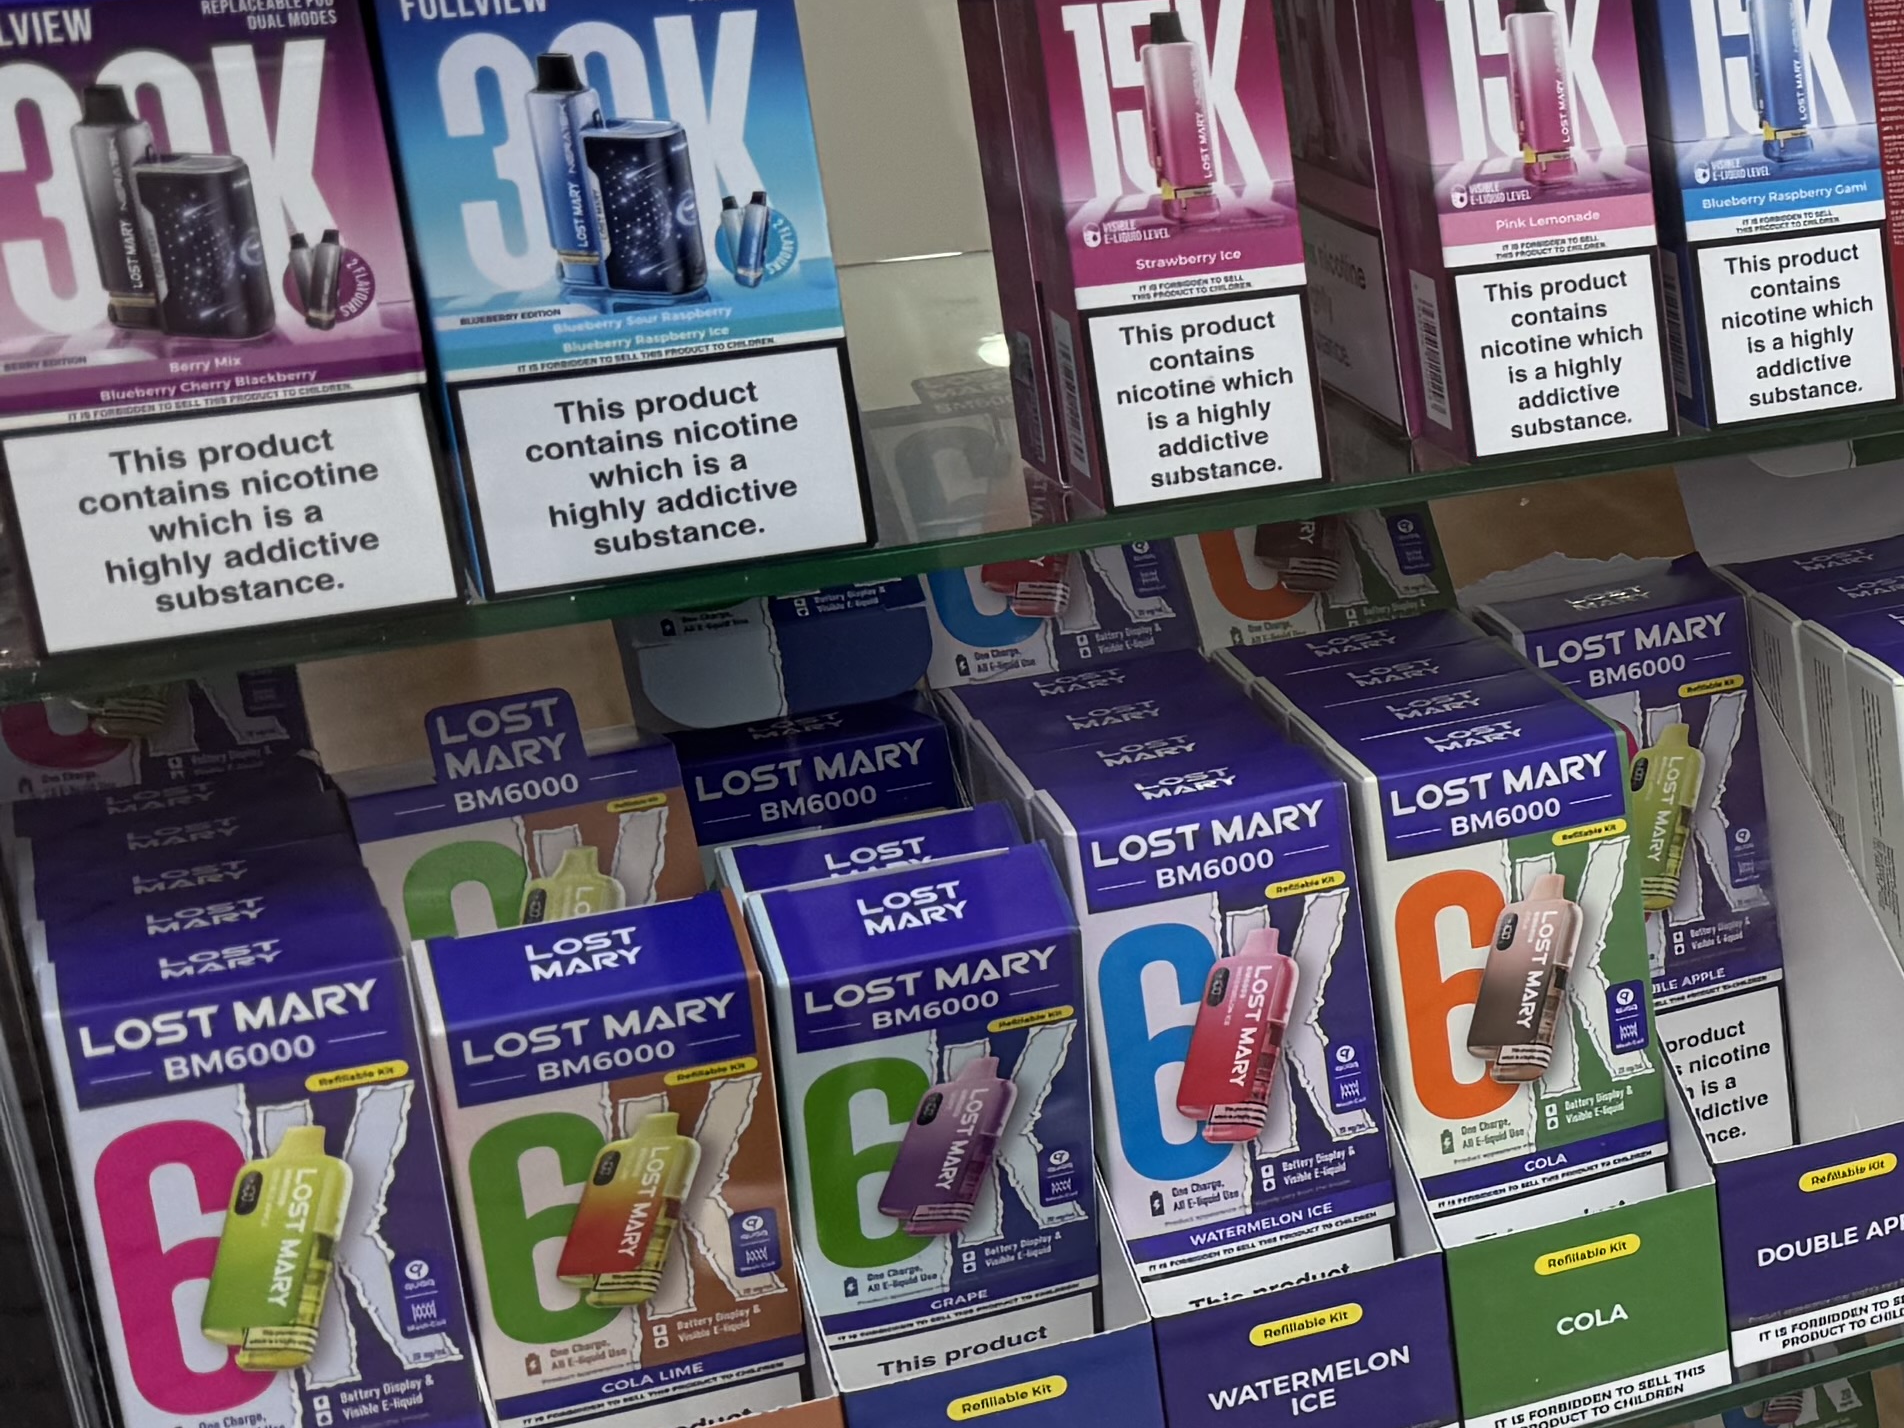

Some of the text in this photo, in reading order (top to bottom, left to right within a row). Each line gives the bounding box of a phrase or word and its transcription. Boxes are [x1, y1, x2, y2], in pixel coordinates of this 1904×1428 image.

[1702, 194, 1766, 209] Blueberry
[1769, 187, 1832, 202] Raspberry
[1496, 211, 1600, 230] Pink Lemonade
[79, 979, 376, 1057] LOST MARY
[164, 1035, 315, 1081] BM6000
[1557, 1304, 1628, 1335] COLA
[1208, 1346, 1409, 1410] WATERMELON
[1292, 1389, 1336, 1415] ICE
